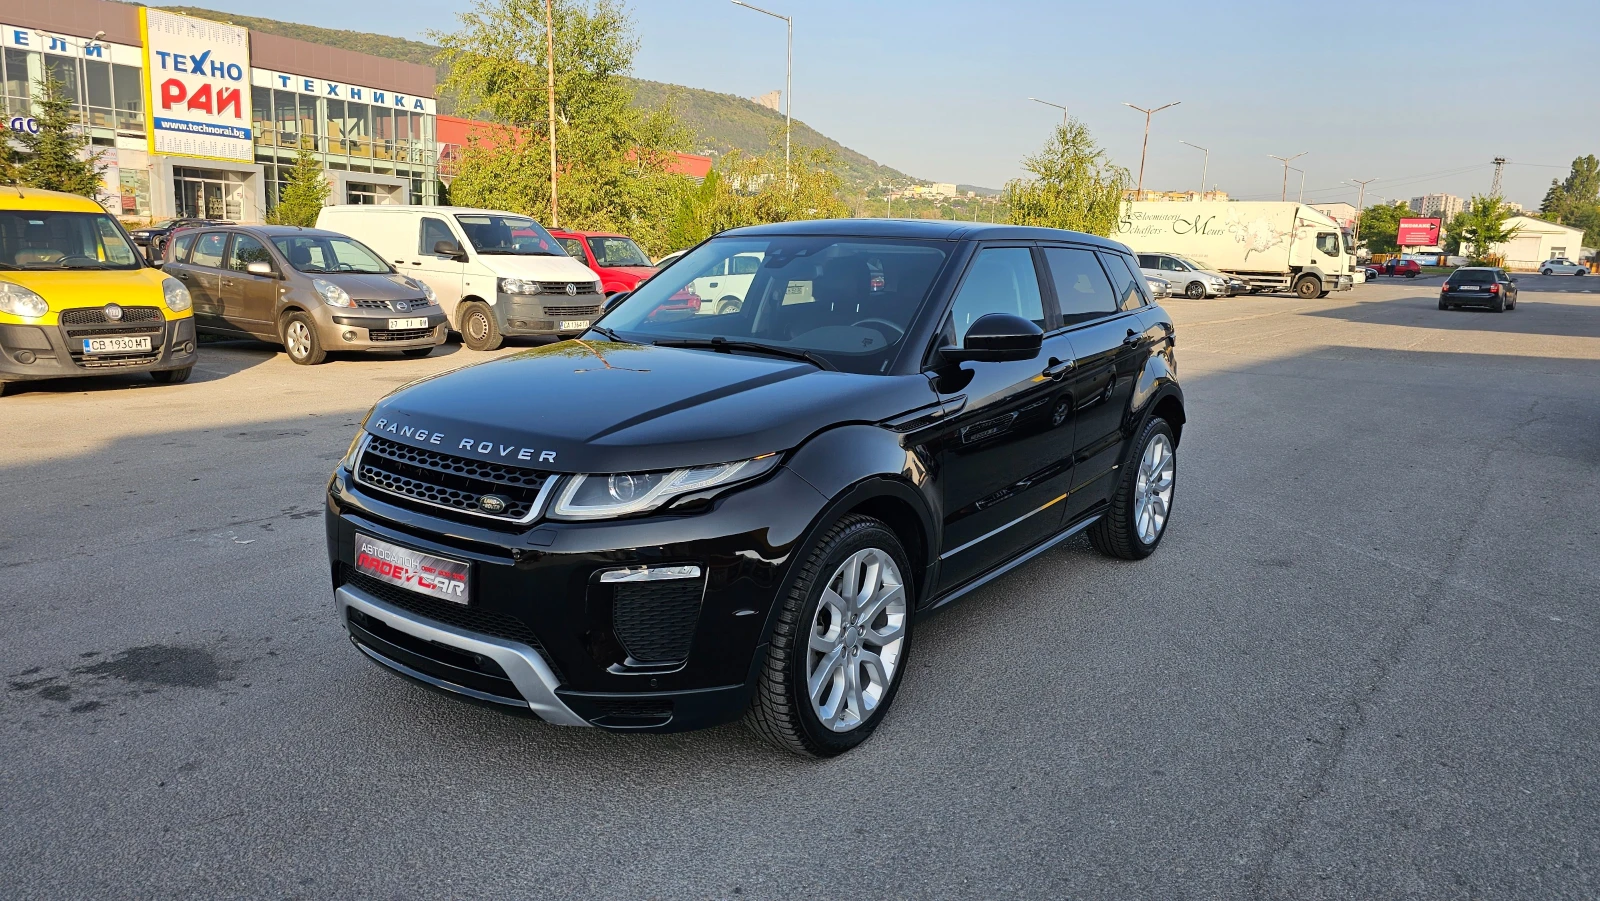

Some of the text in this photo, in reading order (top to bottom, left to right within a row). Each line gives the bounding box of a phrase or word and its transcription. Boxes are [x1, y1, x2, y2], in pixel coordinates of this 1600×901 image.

[155, 50, 243, 81] ТЕХНО
[161, 78, 242, 119] РАЙ
[278, 75, 425, 111] ТЕХНИКА
[161, 121, 245, 138] www.technorai.bg
[1117, 214, 1162, 237] Schaffers
[1172, 214, 1226, 236] Meurs
[1131, 211, 1181, 221] Bloemisterij
[91, 340, 106, 351] CB
[109, 339, 134, 350] 1930
[375, 417, 557, 463] RANGE ROVER
[361, 542, 420, 569] АВТОСАЛОН
